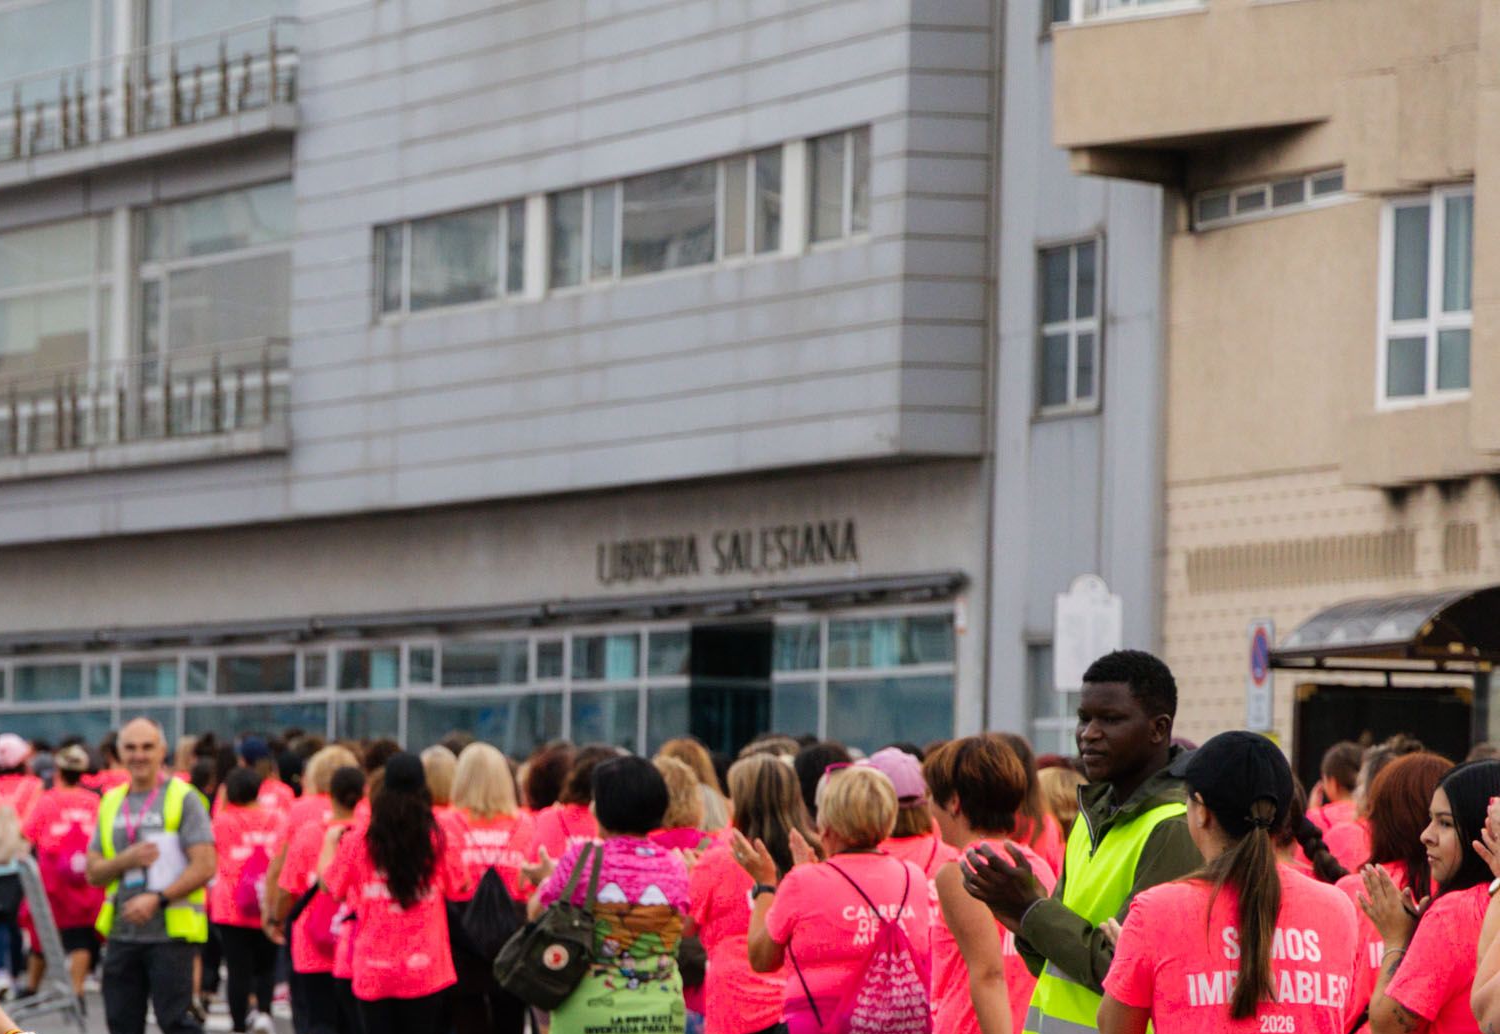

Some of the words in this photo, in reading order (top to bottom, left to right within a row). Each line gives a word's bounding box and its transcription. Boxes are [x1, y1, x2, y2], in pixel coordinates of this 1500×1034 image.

[713, 517, 859, 576] SALESIANA
[1222, 926, 1321, 962] SMOS
[1187, 969, 1348, 1009] IMPABLES
[1260, 1015, 1295, 1034] 2026
